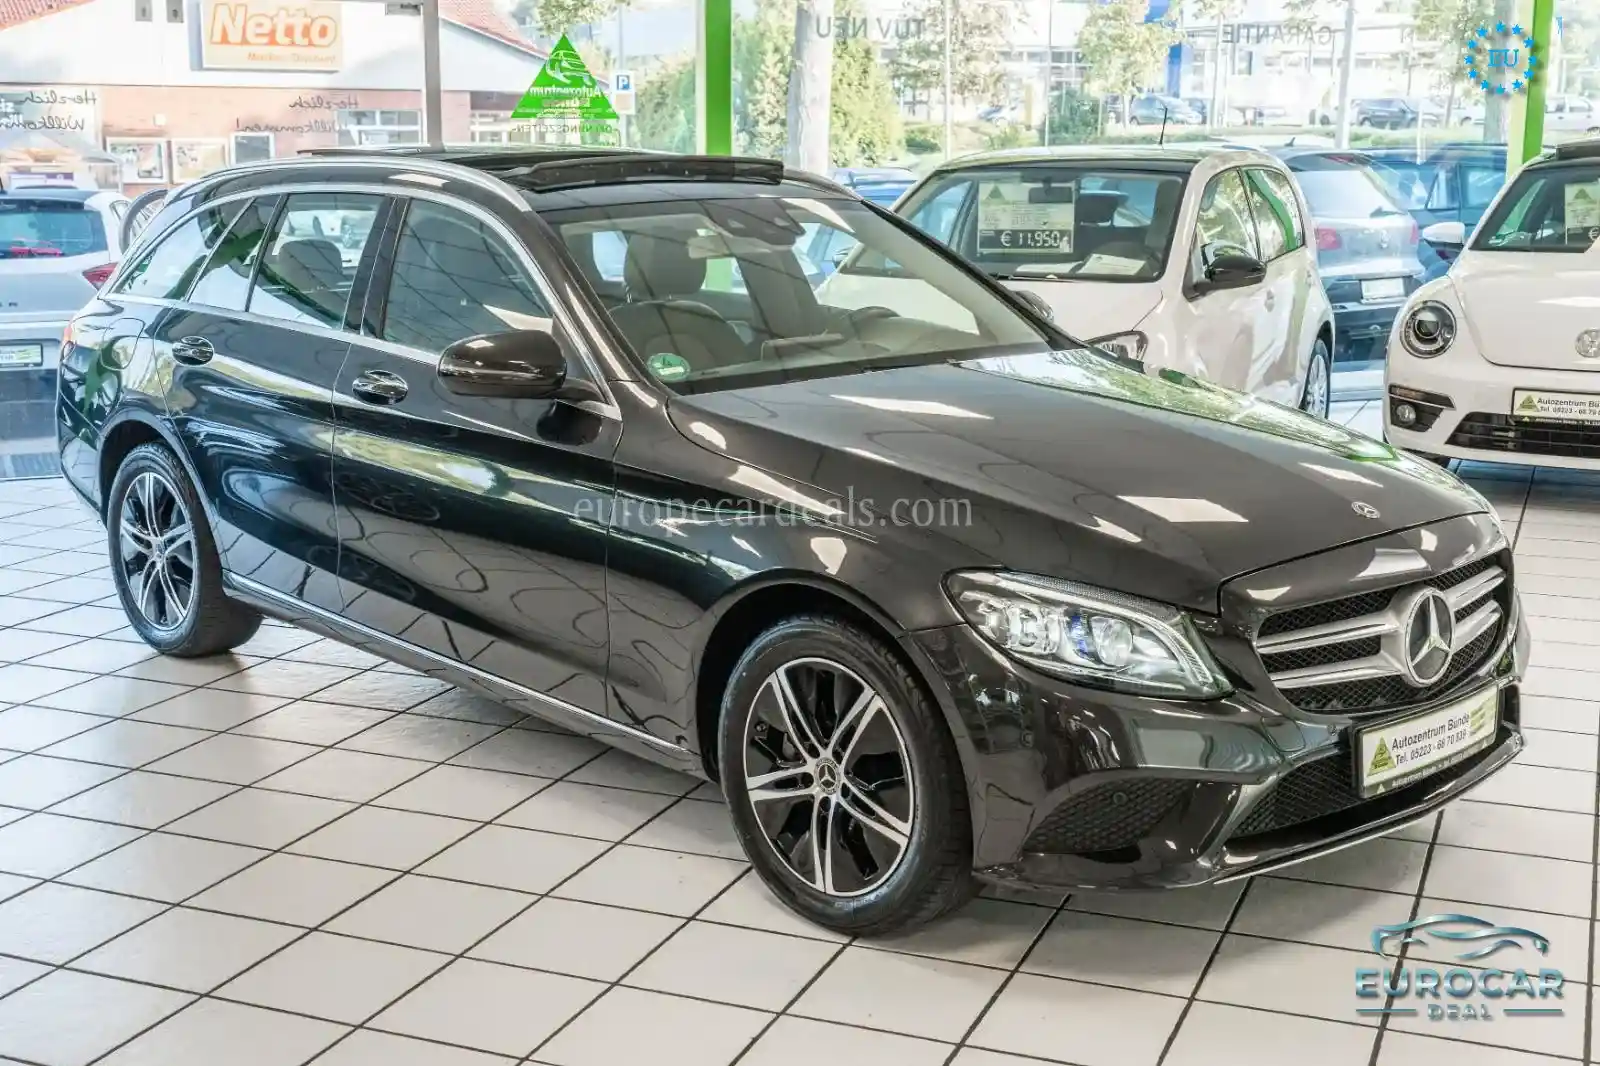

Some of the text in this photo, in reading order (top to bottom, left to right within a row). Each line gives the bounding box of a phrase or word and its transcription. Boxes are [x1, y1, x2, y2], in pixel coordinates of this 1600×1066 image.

[211, 3, 338, 47] Netto
[1000, 230, 1012, 247] €
[1536, 397, 1586, 407] Autozentrum
[1391, 724, 1446, 751] Autozentrum
[1410, 744, 1432, 761] 05223
